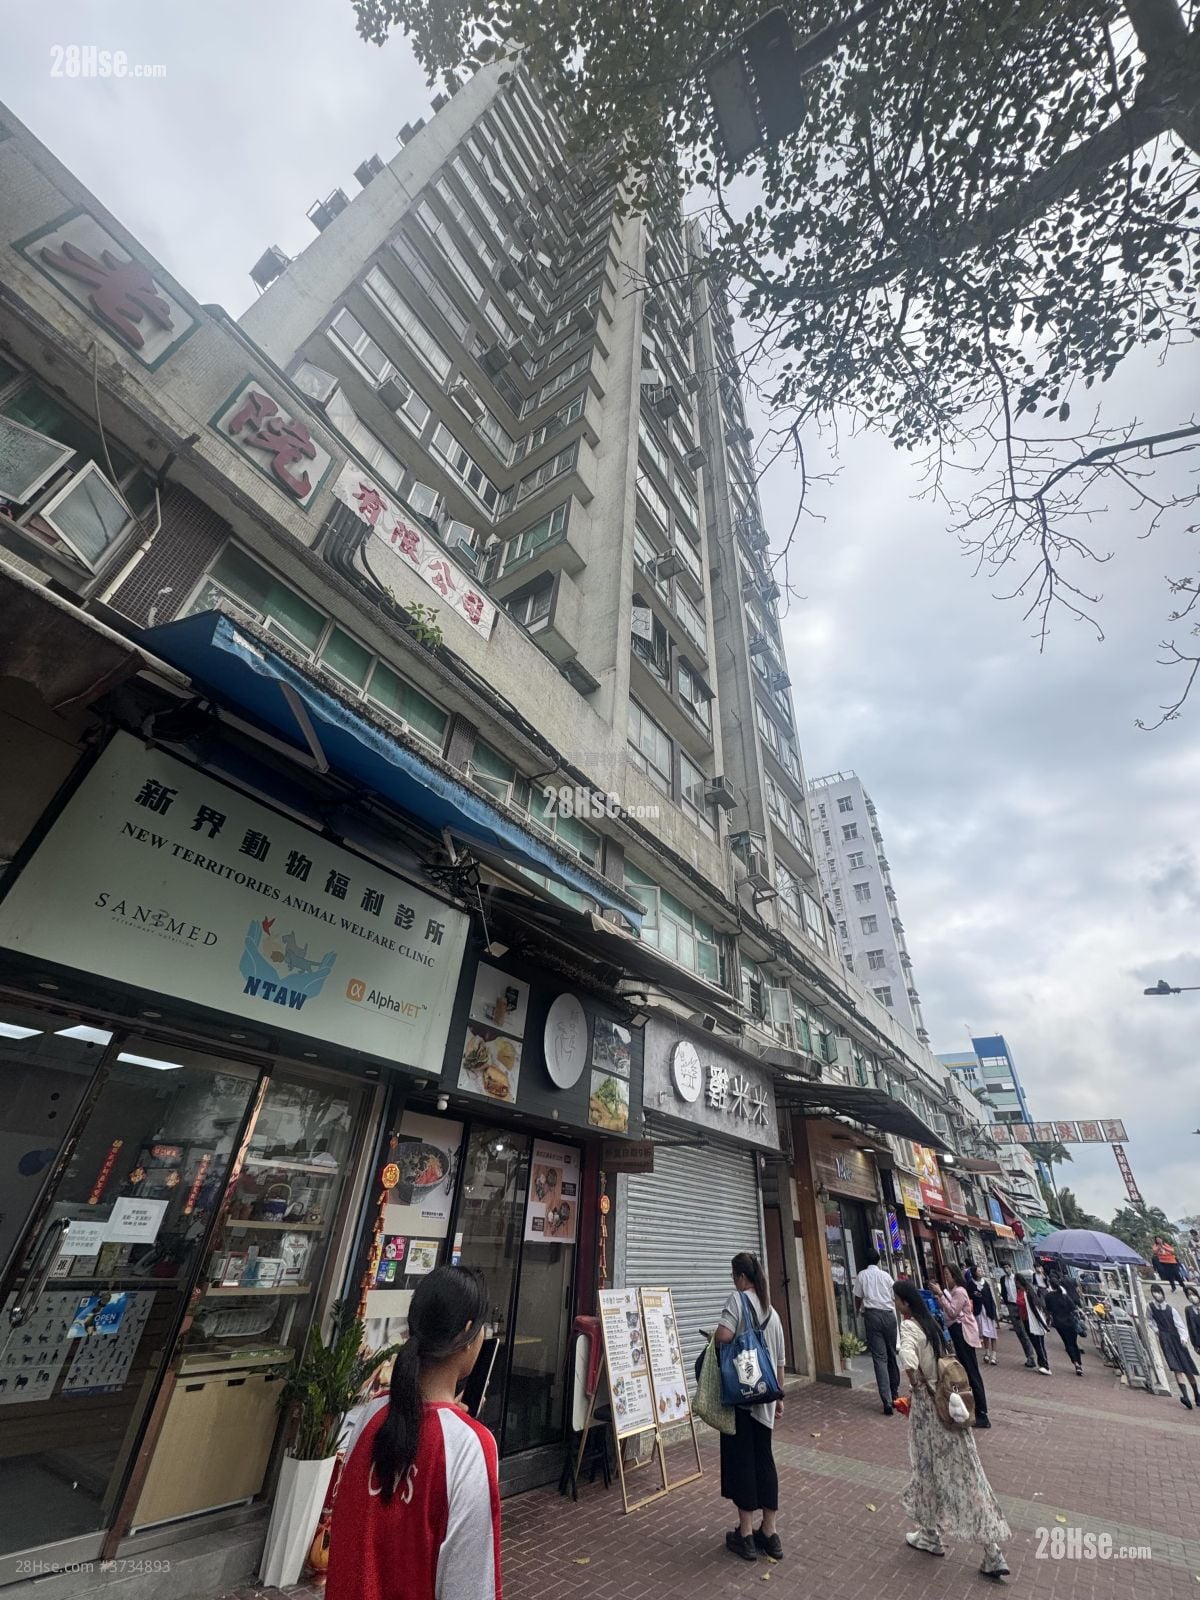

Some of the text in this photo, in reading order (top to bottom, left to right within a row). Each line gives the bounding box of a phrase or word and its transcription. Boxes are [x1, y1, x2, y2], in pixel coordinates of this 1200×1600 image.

[352, 481, 484, 625] 有限公司
[121, 820, 436, 969] NEW TERRITORIES ANIMAL WELFARE CLINIC
[134, 777, 446, 947] 新界動物福利診所
[242, 975, 309, 1012] NTAW
[94, 1313, 116, 1322] OPEN
